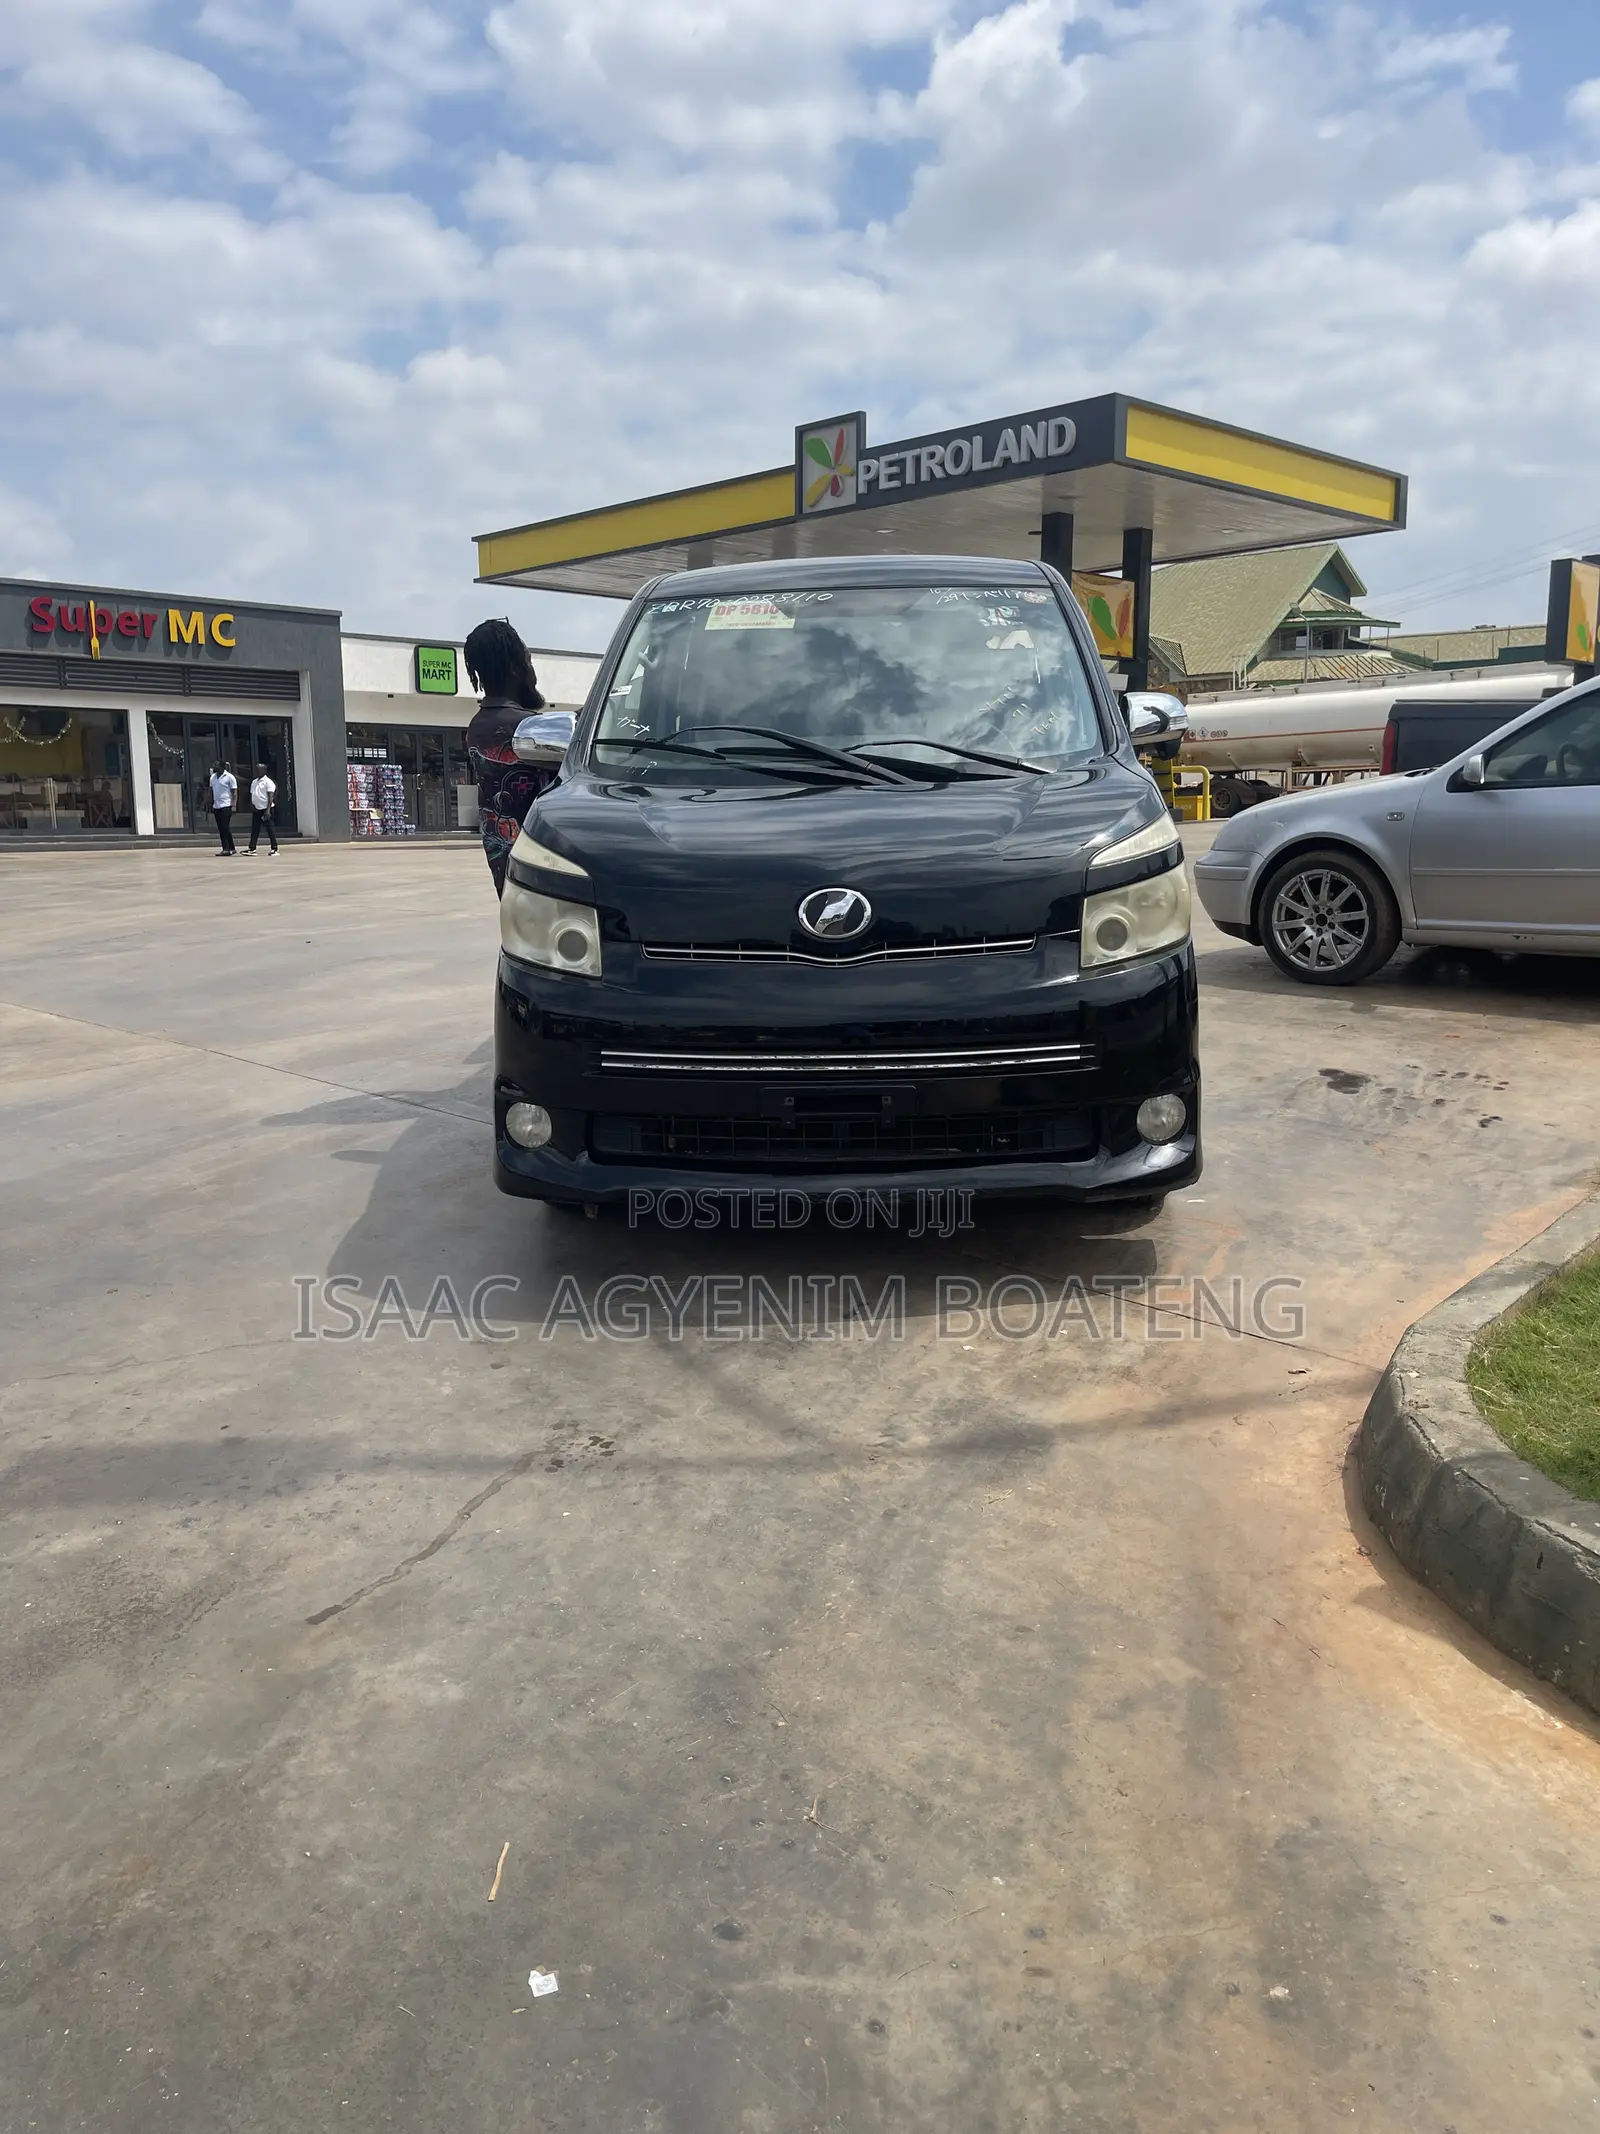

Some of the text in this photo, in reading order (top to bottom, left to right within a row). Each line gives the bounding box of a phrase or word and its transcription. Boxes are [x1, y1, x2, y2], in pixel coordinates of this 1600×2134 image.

[858, 416, 1077, 494] PETROLAND
[714, 604, 738, 616] DP
[30, 596, 236, 659] Super MC
[422, 660, 452, 669] SUPER MC
[422, 668, 452, 680] MART
